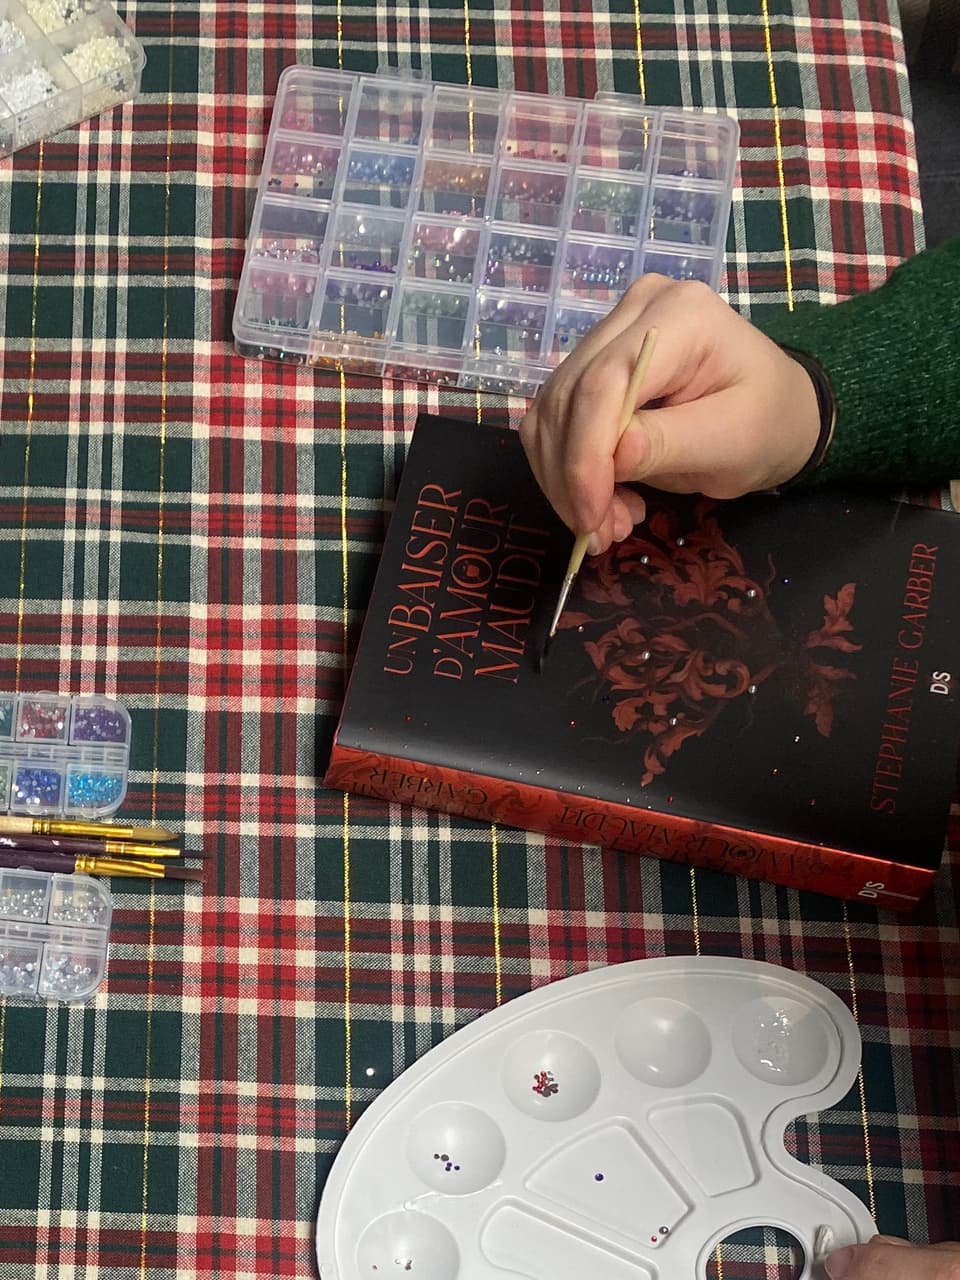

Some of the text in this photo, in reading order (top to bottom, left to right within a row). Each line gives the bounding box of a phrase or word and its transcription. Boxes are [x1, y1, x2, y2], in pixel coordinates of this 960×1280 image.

[384, 483, 463, 675] UN BAISER
[433, 498, 510, 680] D'AMOUR
[474, 512, 551, 685] MAUDIT
[870, 543, 938, 815] STEPHANIE GARBER
